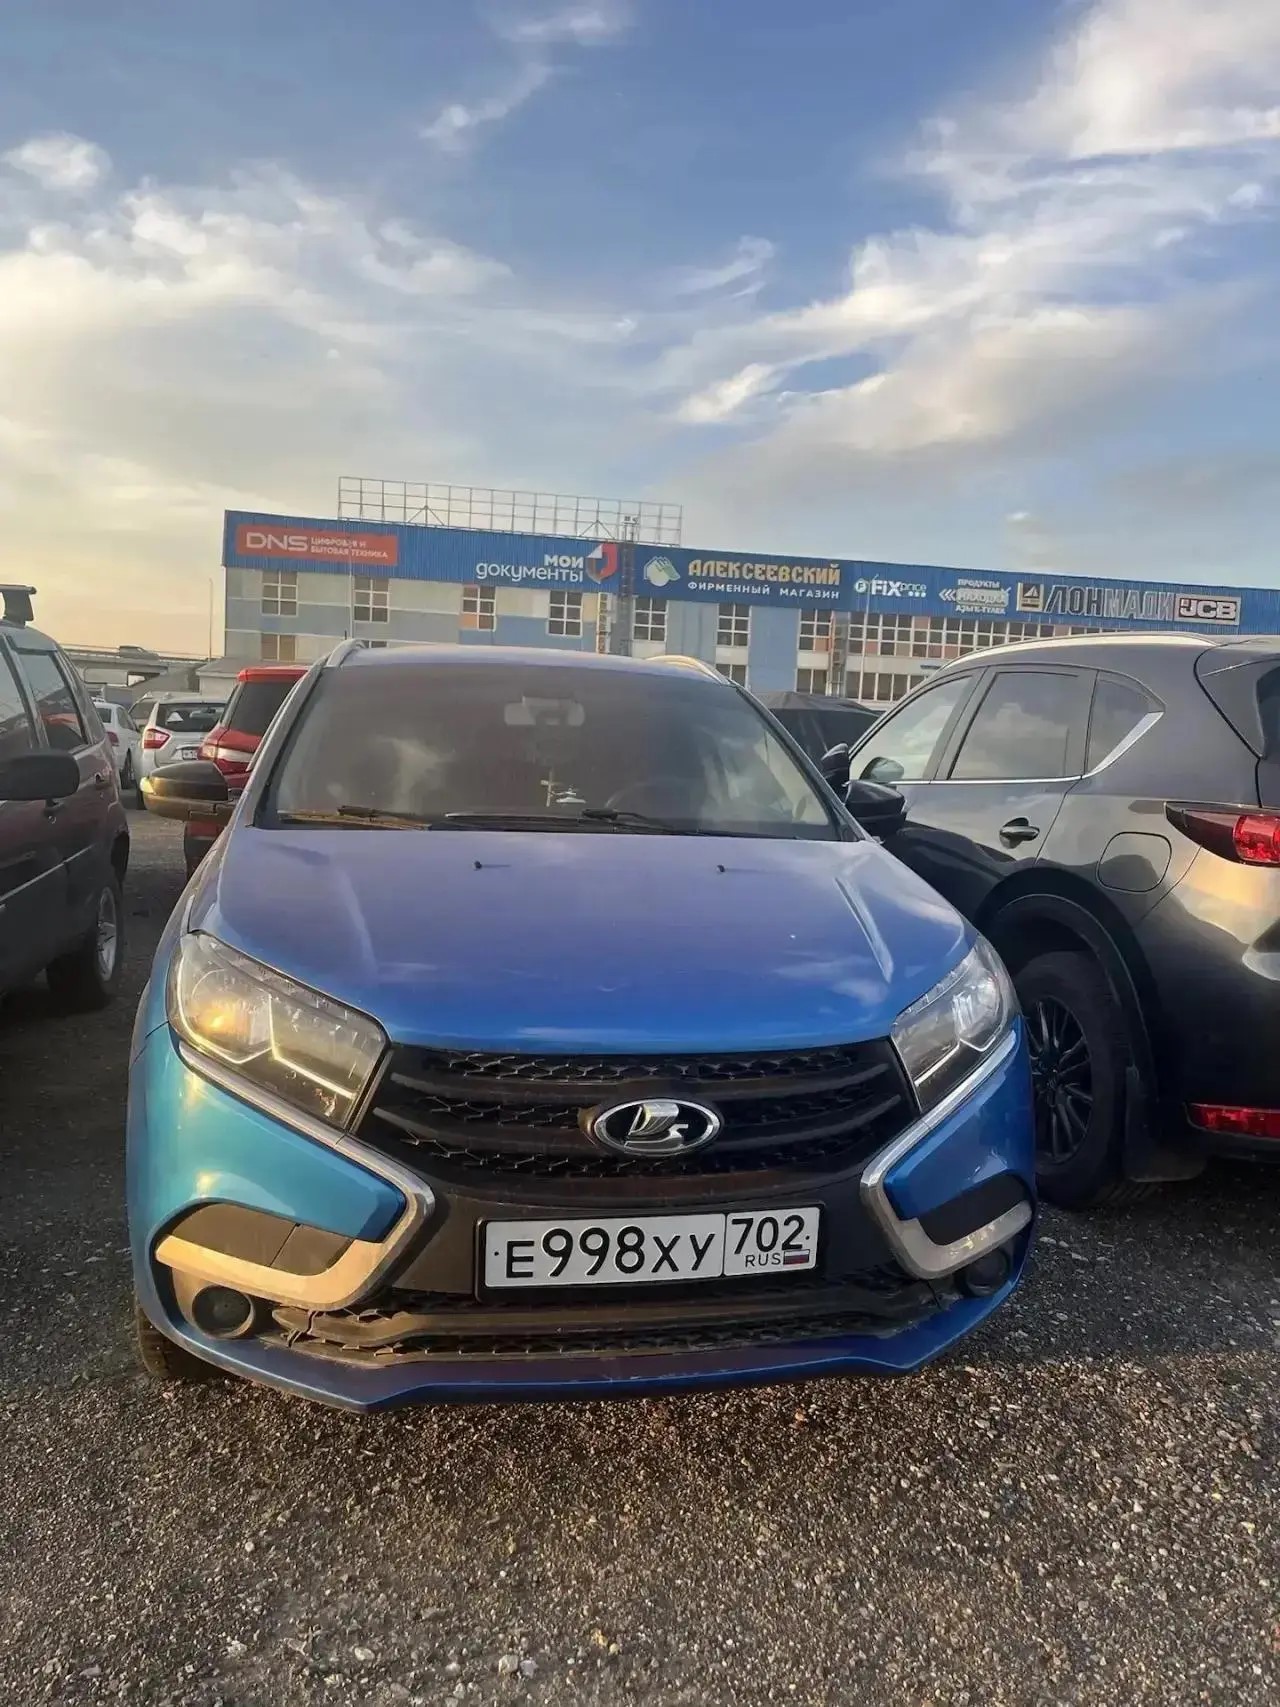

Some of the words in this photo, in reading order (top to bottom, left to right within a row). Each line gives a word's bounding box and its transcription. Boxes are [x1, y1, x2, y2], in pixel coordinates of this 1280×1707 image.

[246, 532, 308, 552] DNS
[351, 548, 389, 559] ТЕХНИКА
[475, 562, 584, 582] документы
[688, 559, 841, 586] АЛЕКСЕЕВСКИЙ
[687, 581, 771, 595] ФИРМЕННЫЙ
[779, 587, 840, 600] МАГАЗИН
[957, 578, 1000, 589] ПРОДУКТЫ
[1043, 584, 1175, 622] ЛОНМАДИ
[1179, 597, 1238, 621] JCB
[731, 1214, 805, 1255] 702
[745, 1252, 782, 1268] RUS
